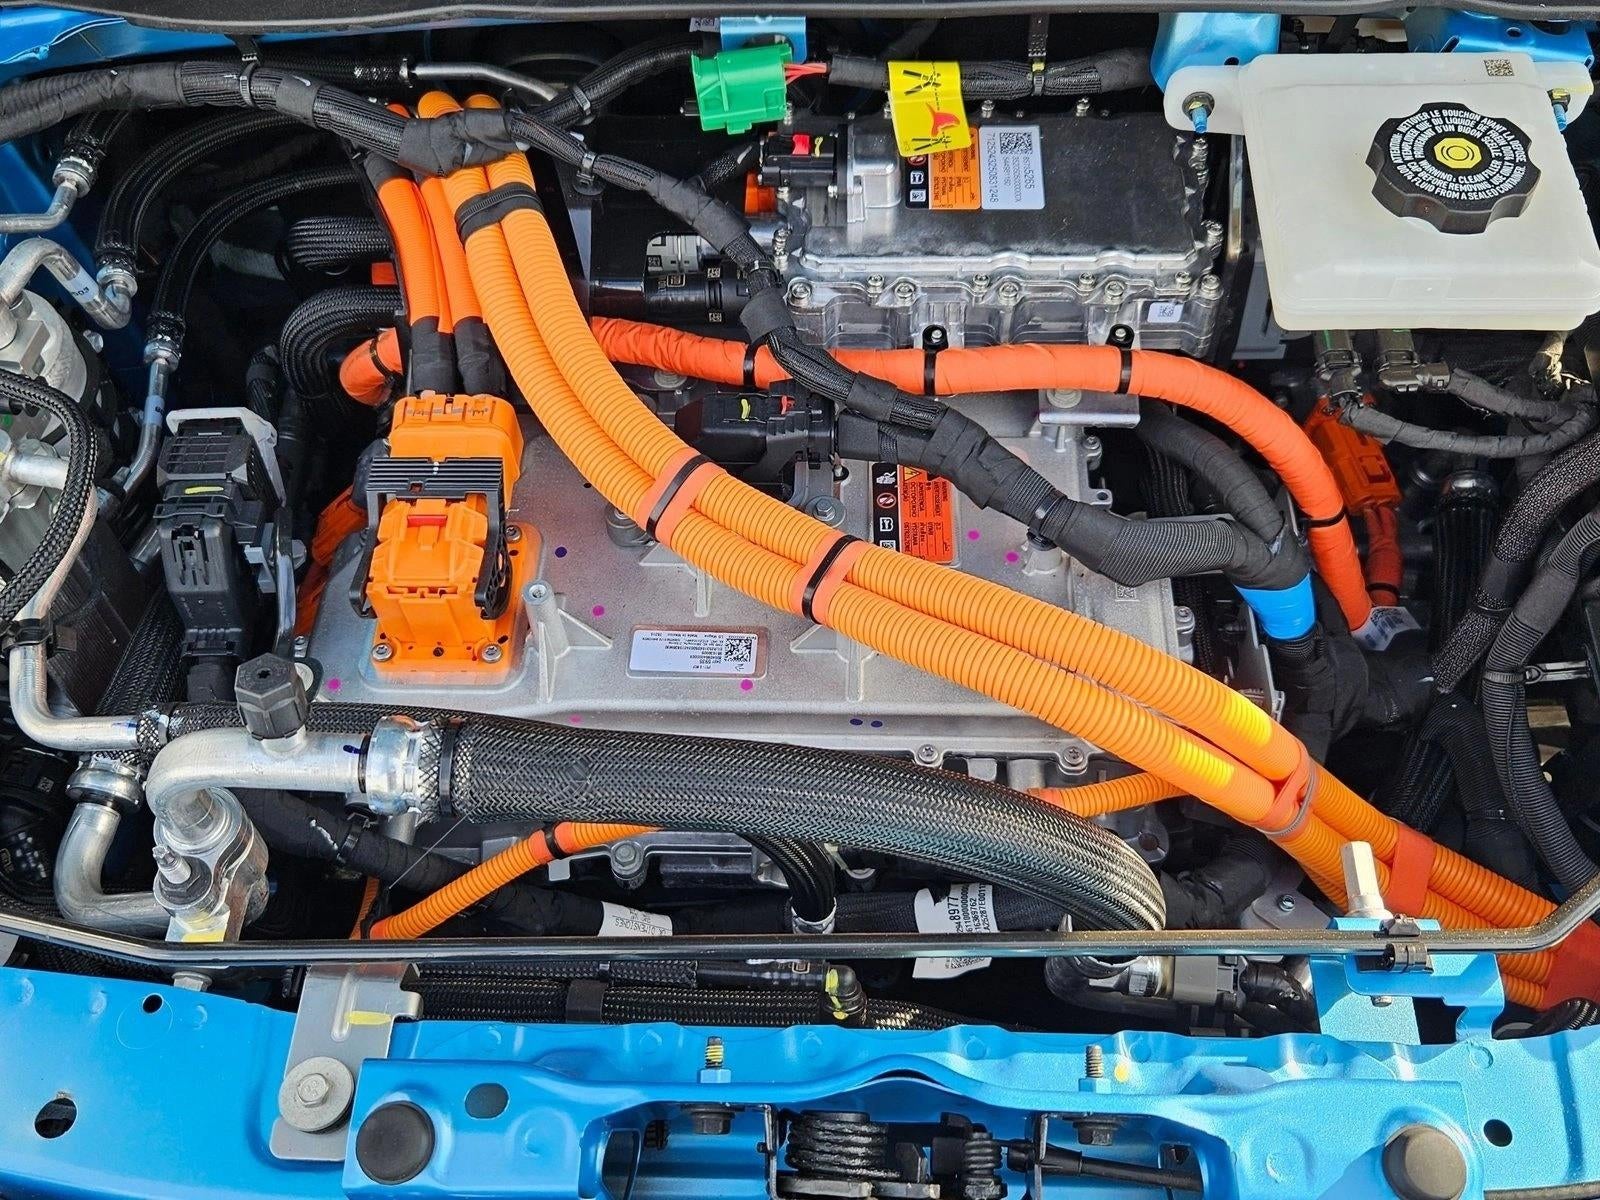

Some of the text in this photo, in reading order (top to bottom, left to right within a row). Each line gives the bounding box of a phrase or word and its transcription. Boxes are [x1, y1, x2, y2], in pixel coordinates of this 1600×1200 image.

[1396, 111, 1431, 133] NETTOYER
[1429, 109, 1441, 118] LE
[1442, 109, 1481, 121] BOUCHON
[1480, 117, 1507, 133] AVANT
[1502, 131, 1515, 141] LA
[1415, 120, 1432, 131] QUE
[1431, 117, 1443, 126] DU
[1445, 117, 1476, 128] LIQUIDE
[1476, 123, 1489, 133] DE
[1486, 129, 1508, 146] FREIN
[1413, 128, 1436, 159] PROVENANT
[1434, 124, 1455, 133] D'UN
[1457, 125, 1483, 139] BIDON
[1396, 164, 1416, 180] DOT4
[1411, 177, 1436, 193] FLUID
[1434, 187, 1460, 200] FROM
[1460, 192, 1467, 200] A
[1467, 188, 1499, 200] SEALED
[1407, 161, 1422, 173] CAP
[1417, 170, 1448, 189] BEFORE
[1489, 173, 1507, 186] USE
[1500, 161, 1515, 177] ONLY
[1458, 173, 1486, 184] CLEAN
[1481, 159, 1503, 179] FILLER
